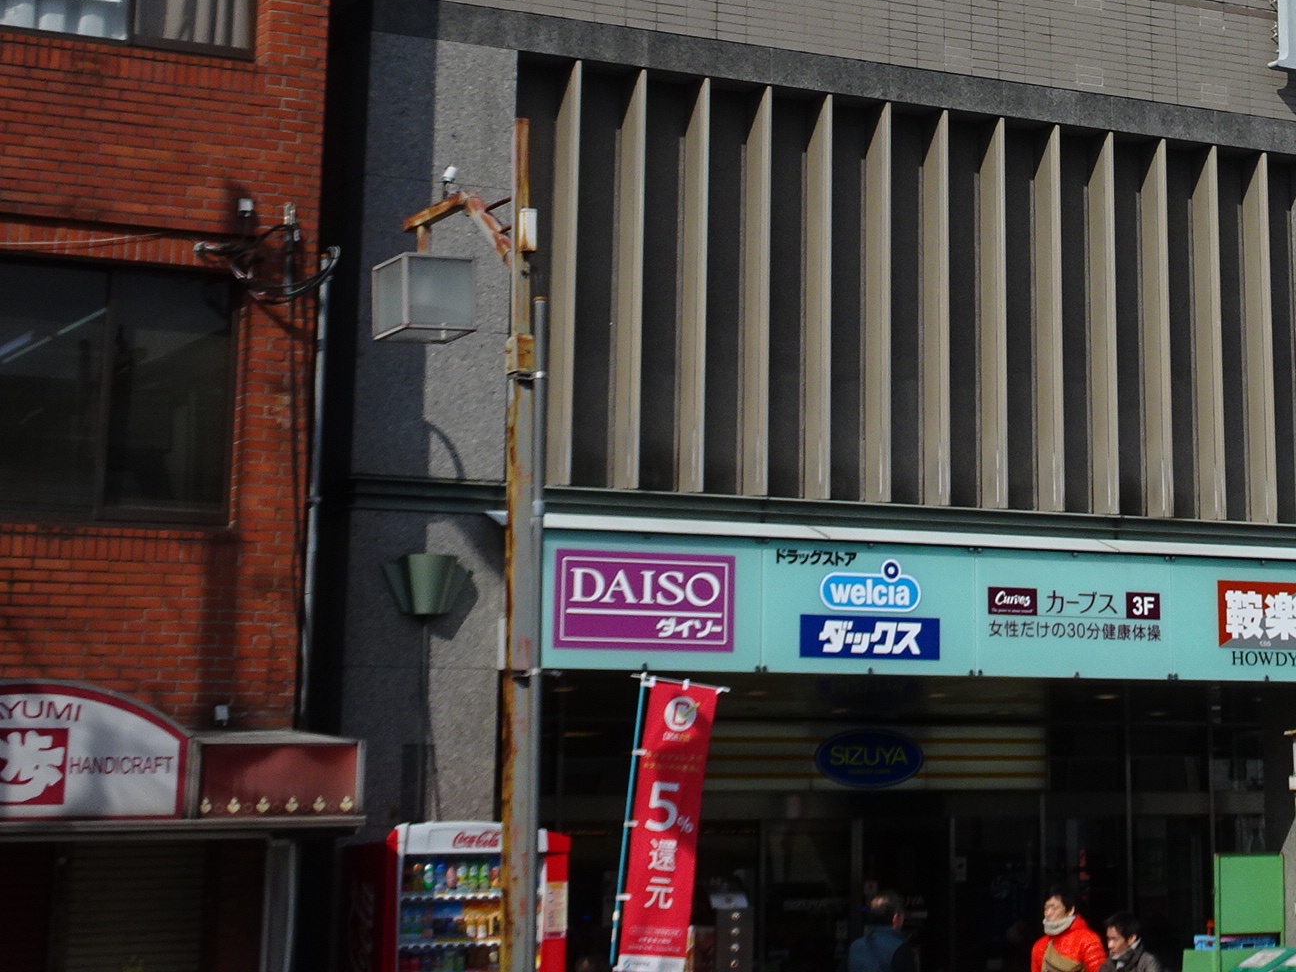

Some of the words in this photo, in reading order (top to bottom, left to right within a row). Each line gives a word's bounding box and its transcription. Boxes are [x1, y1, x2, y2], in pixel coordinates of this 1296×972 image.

[776, 550, 857, 567] ドラッグストア
[569, 567, 721, 607] DAISO
[829, 573, 911, 607] welcia
[994, 590, 1031, 607] Curves
[1046, 590, 1119, 614] カーブス
[1132, 596, 1155, 616] 3F
[656, 617, 723, 639] ダイソー
[818, 619, 922, 655] ダックス
[988, 619, 1162, 642] 女性だけの30分健康体操
[0, 699, 83, 723] YUMI
[69, 755, 174, 776] HANDICRAFT
[830, 744, 909, 766] SIZUYA
[644, 780, 695, 835] 5%
[644, 838, 679, 910] 還元
